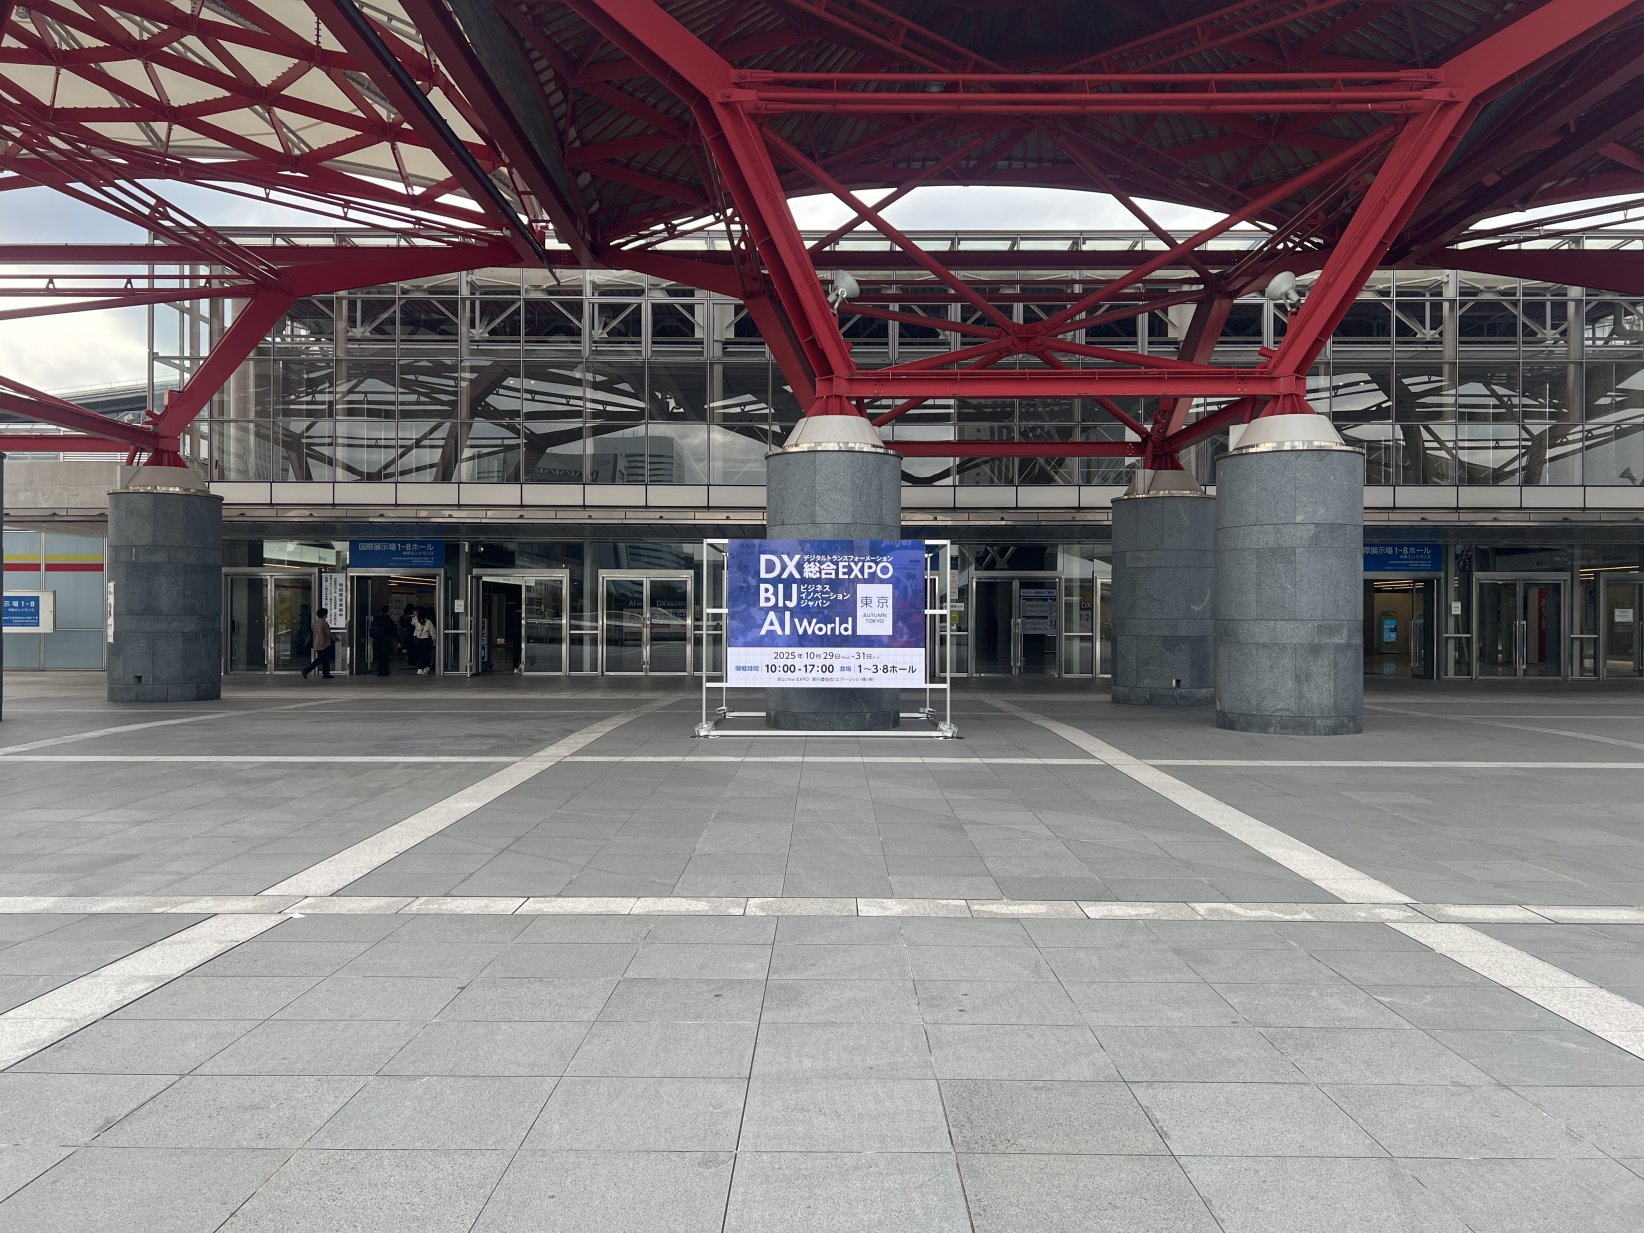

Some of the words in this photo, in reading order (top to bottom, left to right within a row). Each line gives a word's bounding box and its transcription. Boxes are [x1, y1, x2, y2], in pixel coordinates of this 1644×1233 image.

[760, 554, 801, 579] DX
[803, 562, 894, 579] 総合EXPO
[760, 584, 798, 607] BIJ
[860, 596, 889, 609] 東京
[760, 611, 791, 635] AI
[794, 617, 853, 635] World
